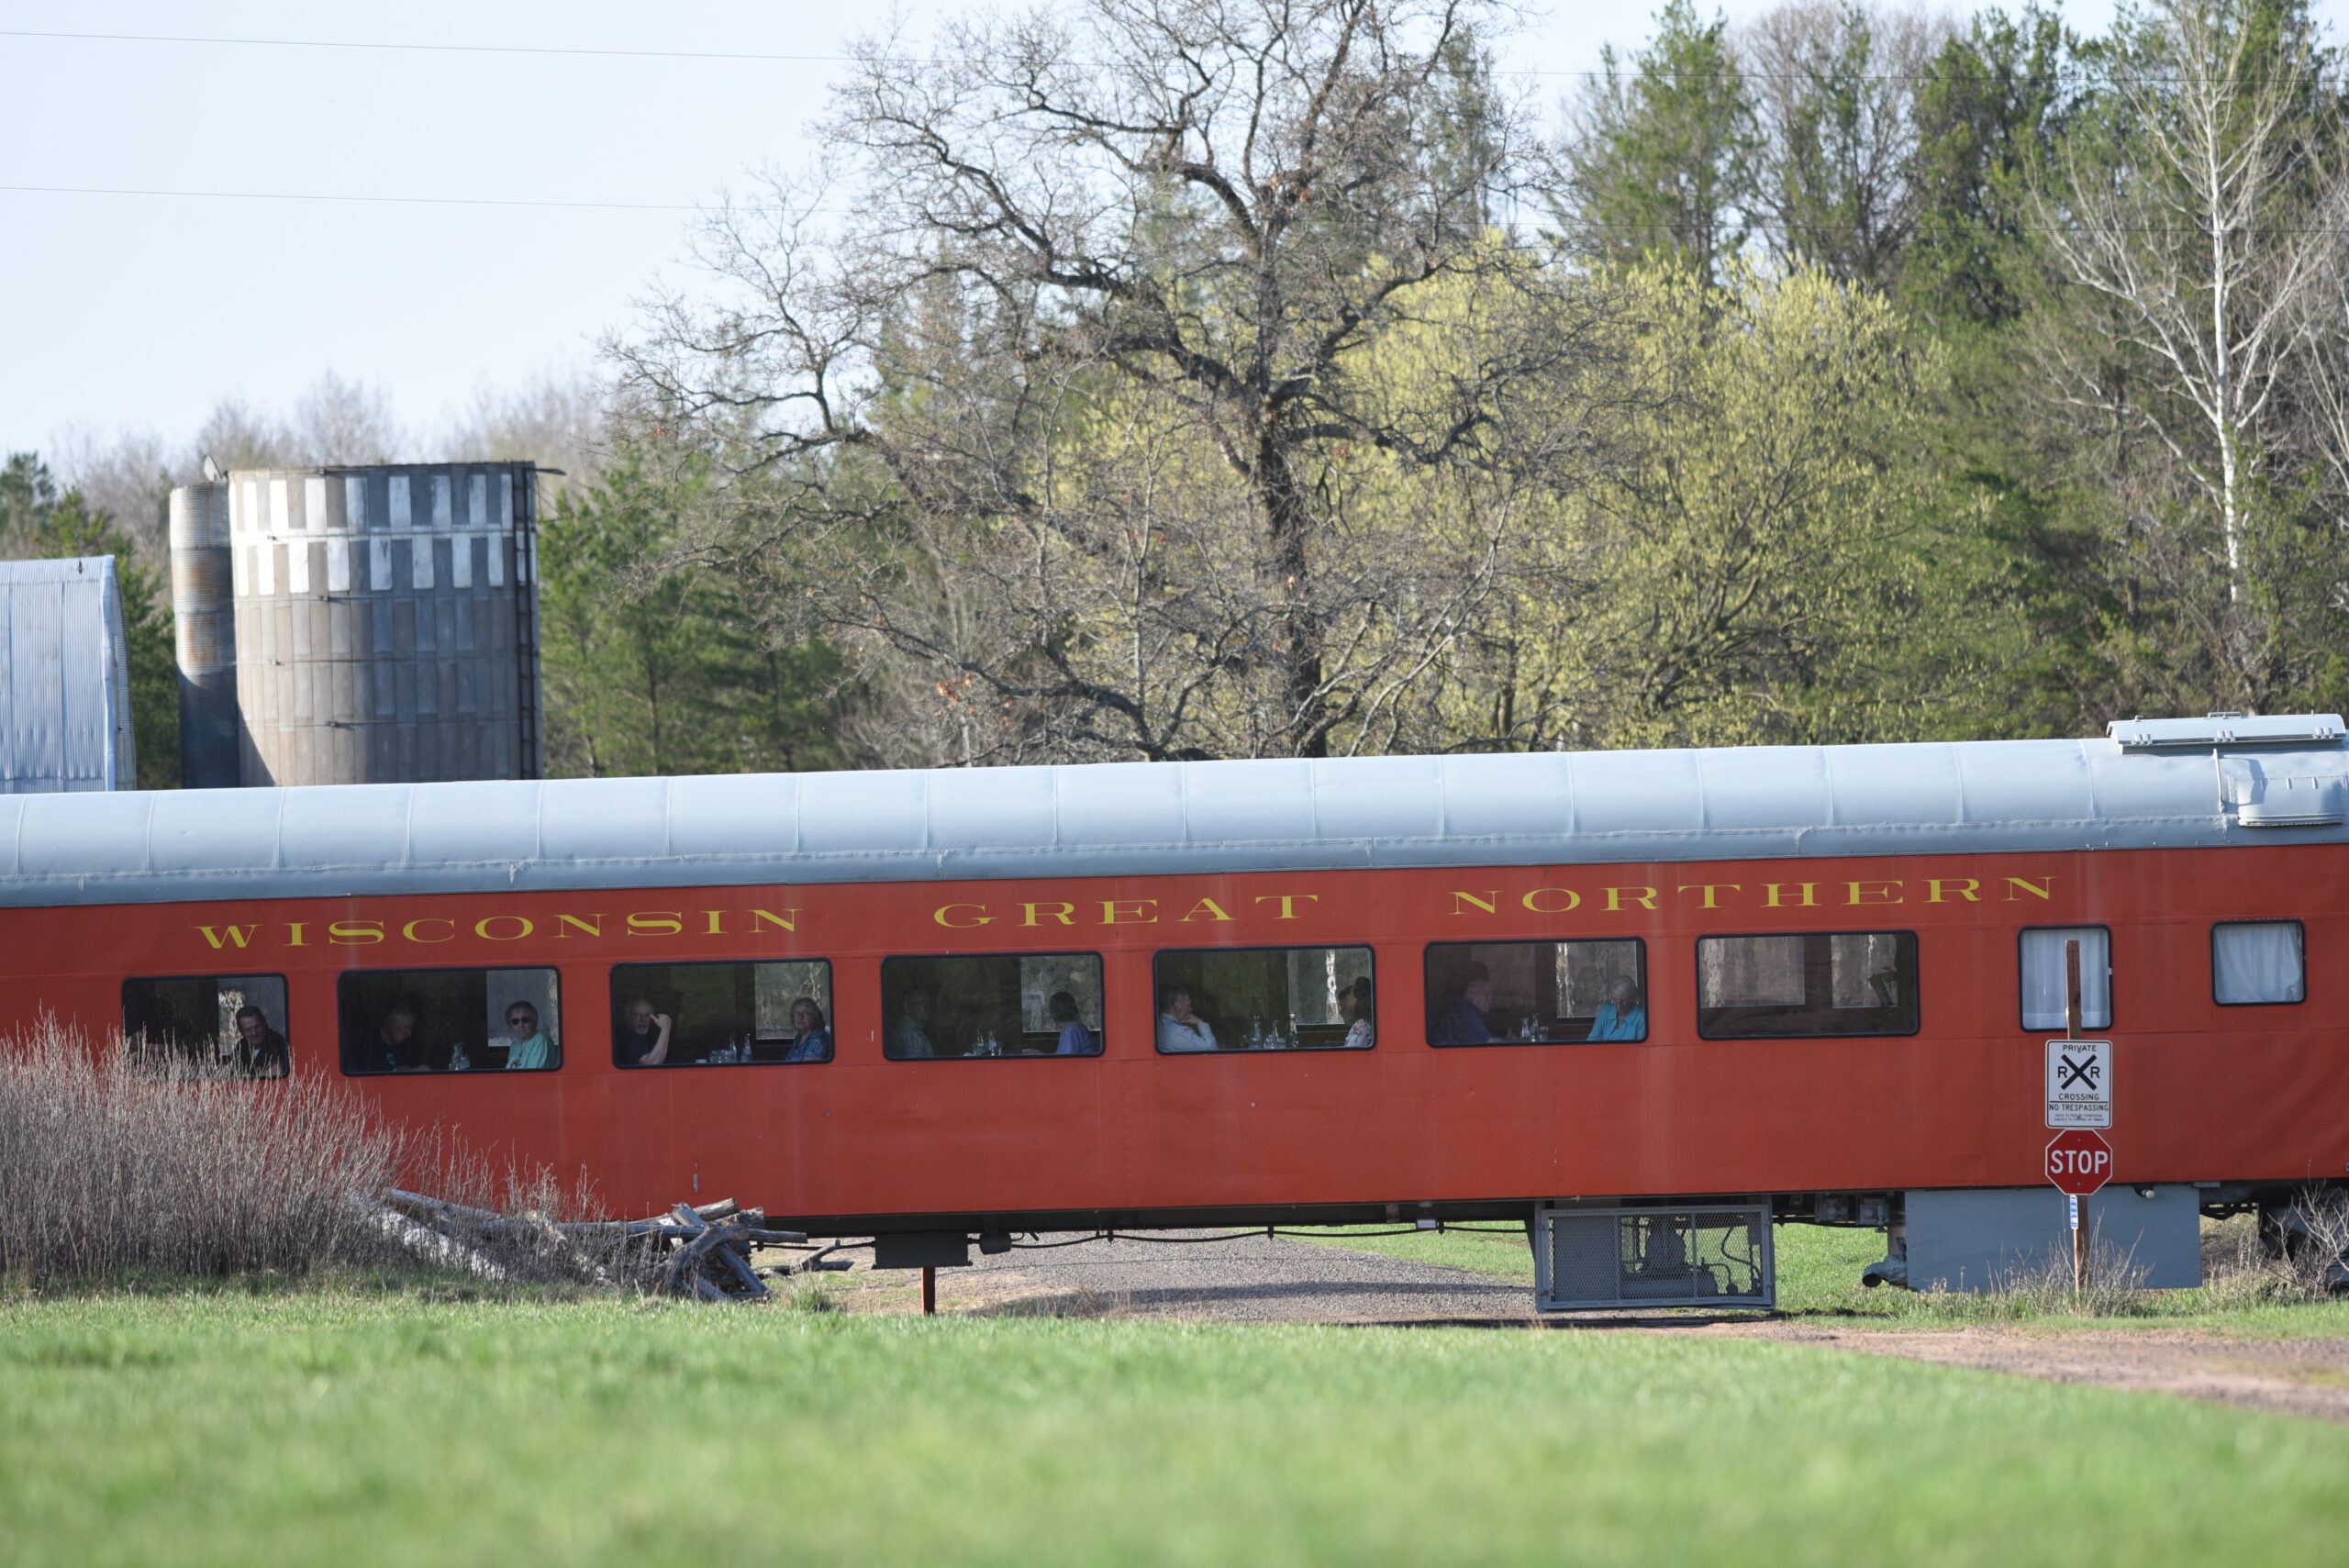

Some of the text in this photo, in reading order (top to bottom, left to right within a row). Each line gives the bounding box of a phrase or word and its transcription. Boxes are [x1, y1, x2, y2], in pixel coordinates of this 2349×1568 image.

[193, 876, 2056, 949] WISCONSIN GREAT NORTHERN
[2062, 1044, 2098, 1052] PRIVATE
[2057, 1066, 2101, 1079] R R
[2058, 1093, 2100, 1101] CROSSING
[2062, 1104, 2110, 1112] TRESPASSING
[2050, 1150, 2109, 1173] STOP
